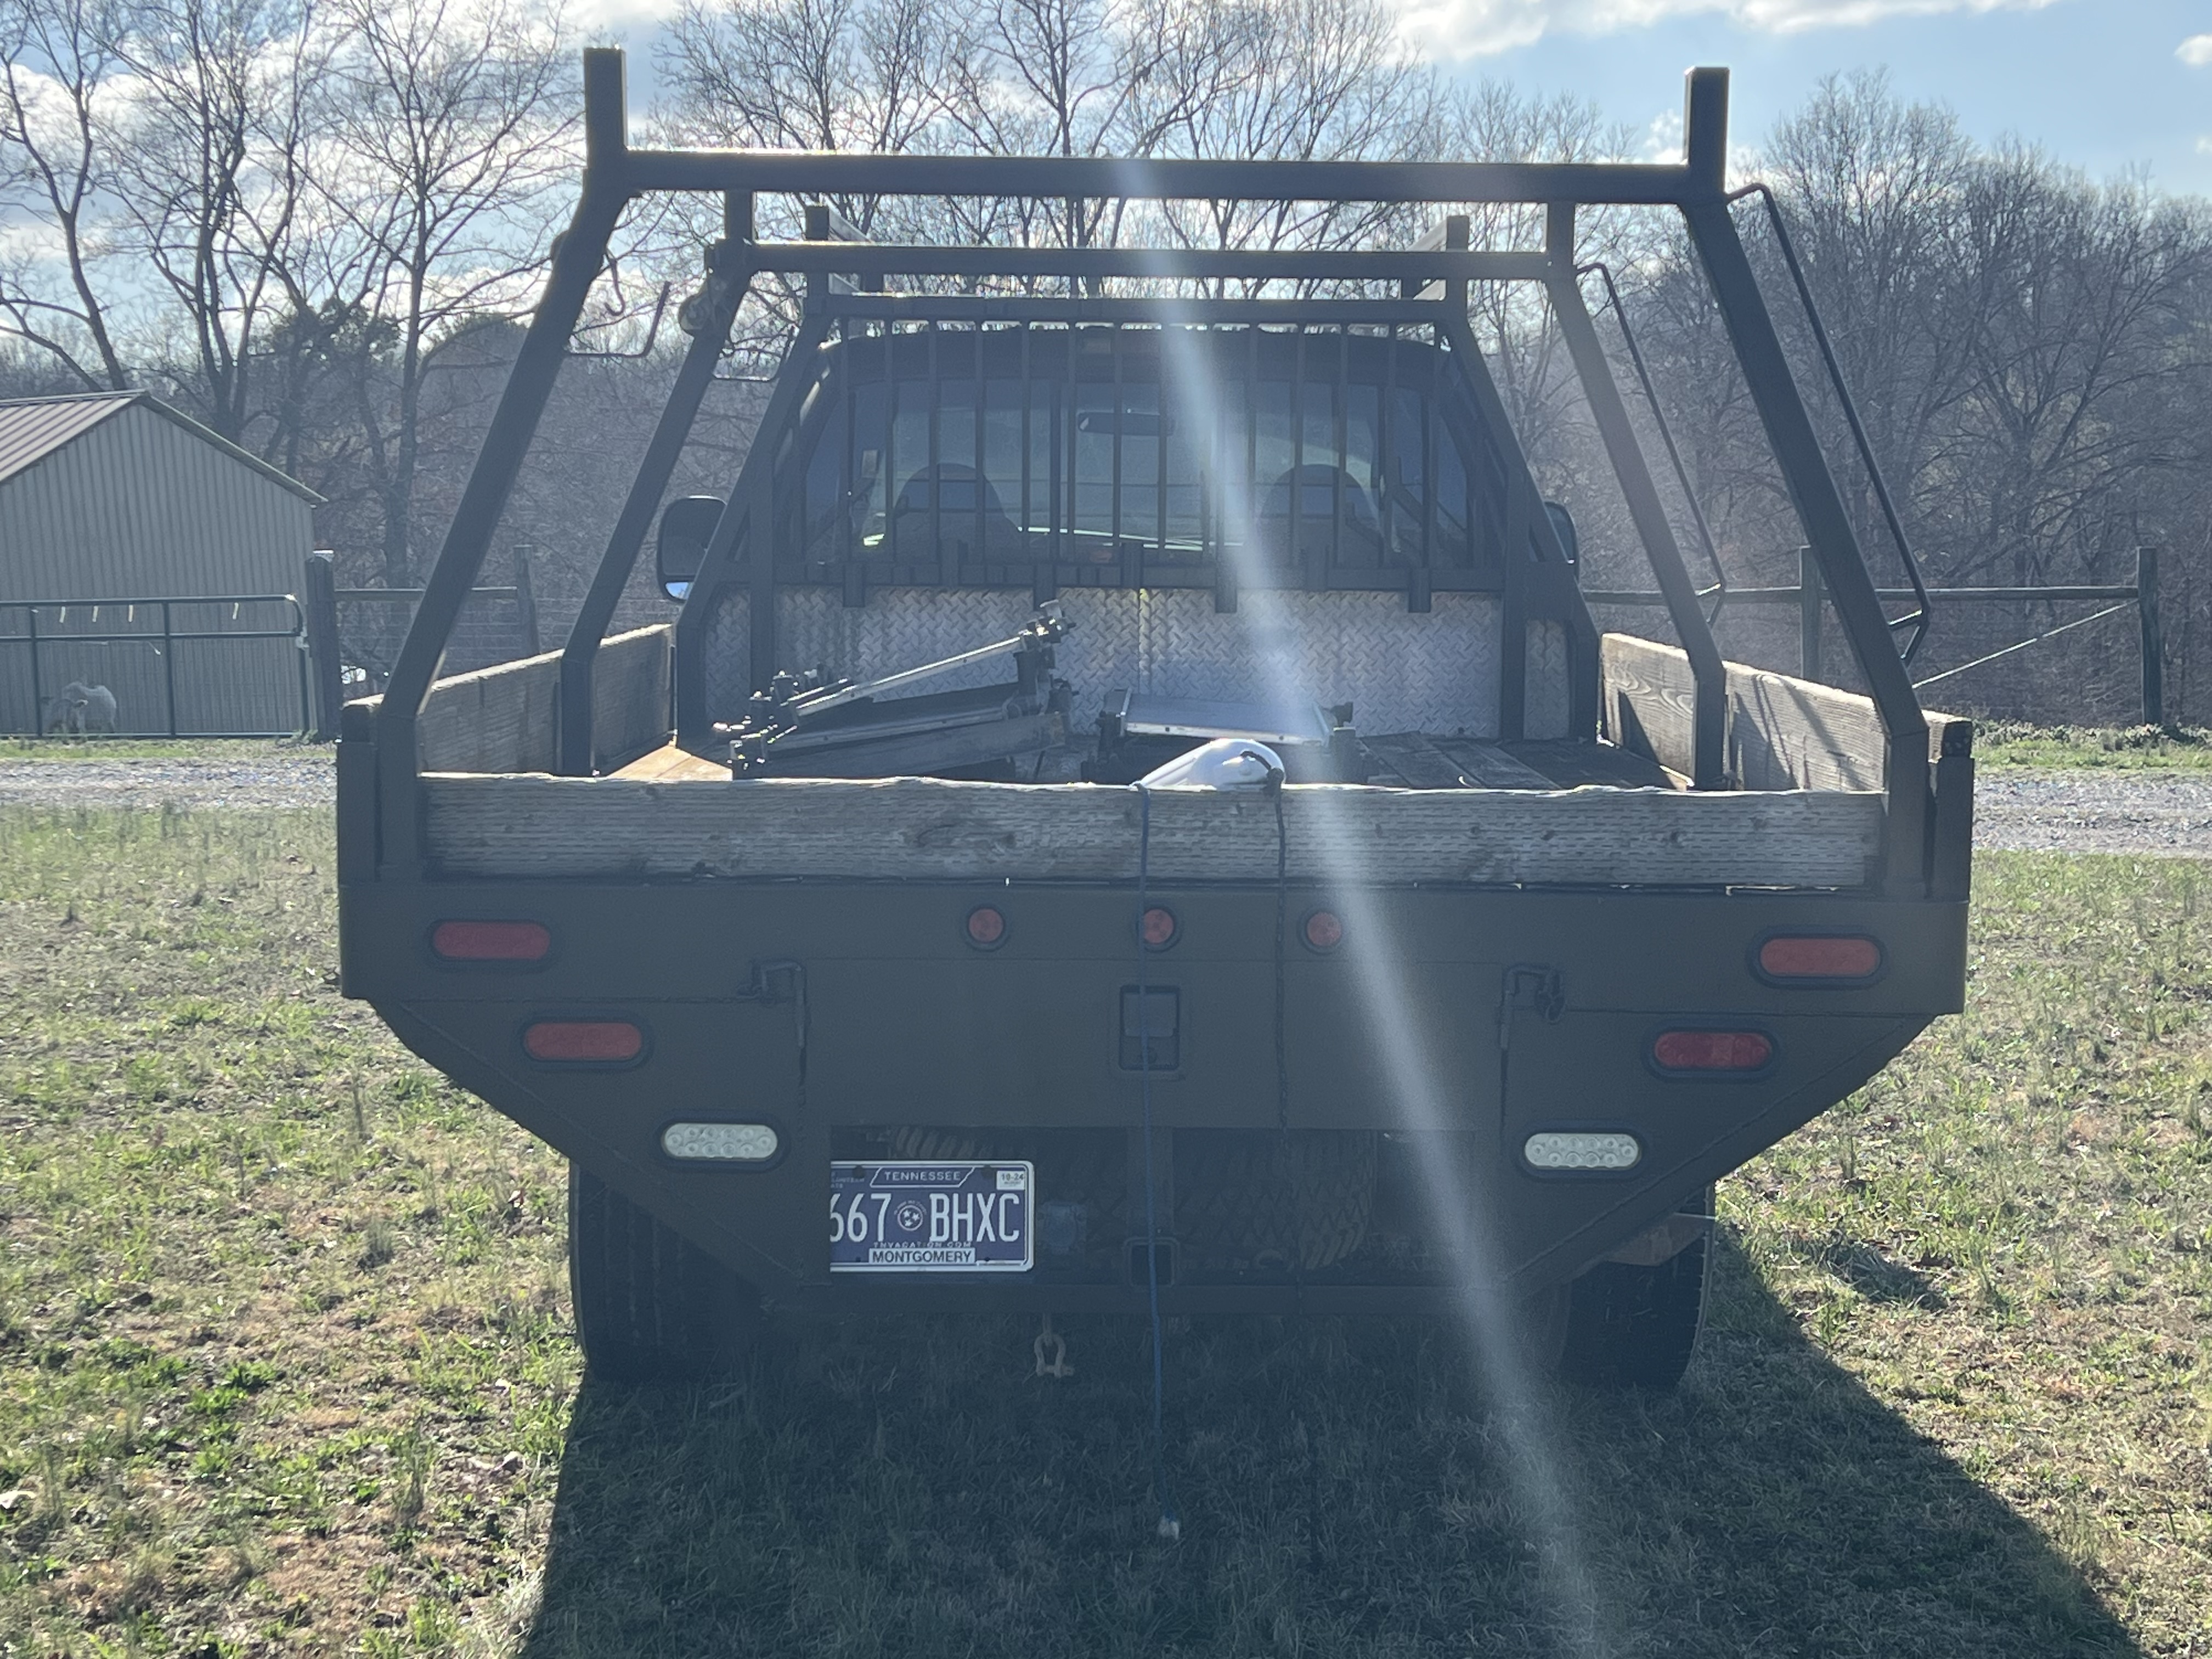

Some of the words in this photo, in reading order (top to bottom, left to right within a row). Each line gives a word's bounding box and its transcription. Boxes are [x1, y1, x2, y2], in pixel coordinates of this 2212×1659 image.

[884, 1171, 961, 1181] TENNESSEE
[1001, 1172, 1024, 1181] 10-24
[830, 1193, 891, 1243] 667
[929, 1193, 1019, 1242] BHXC
[872, 1251, 972, 1262] MONTGOMERY
